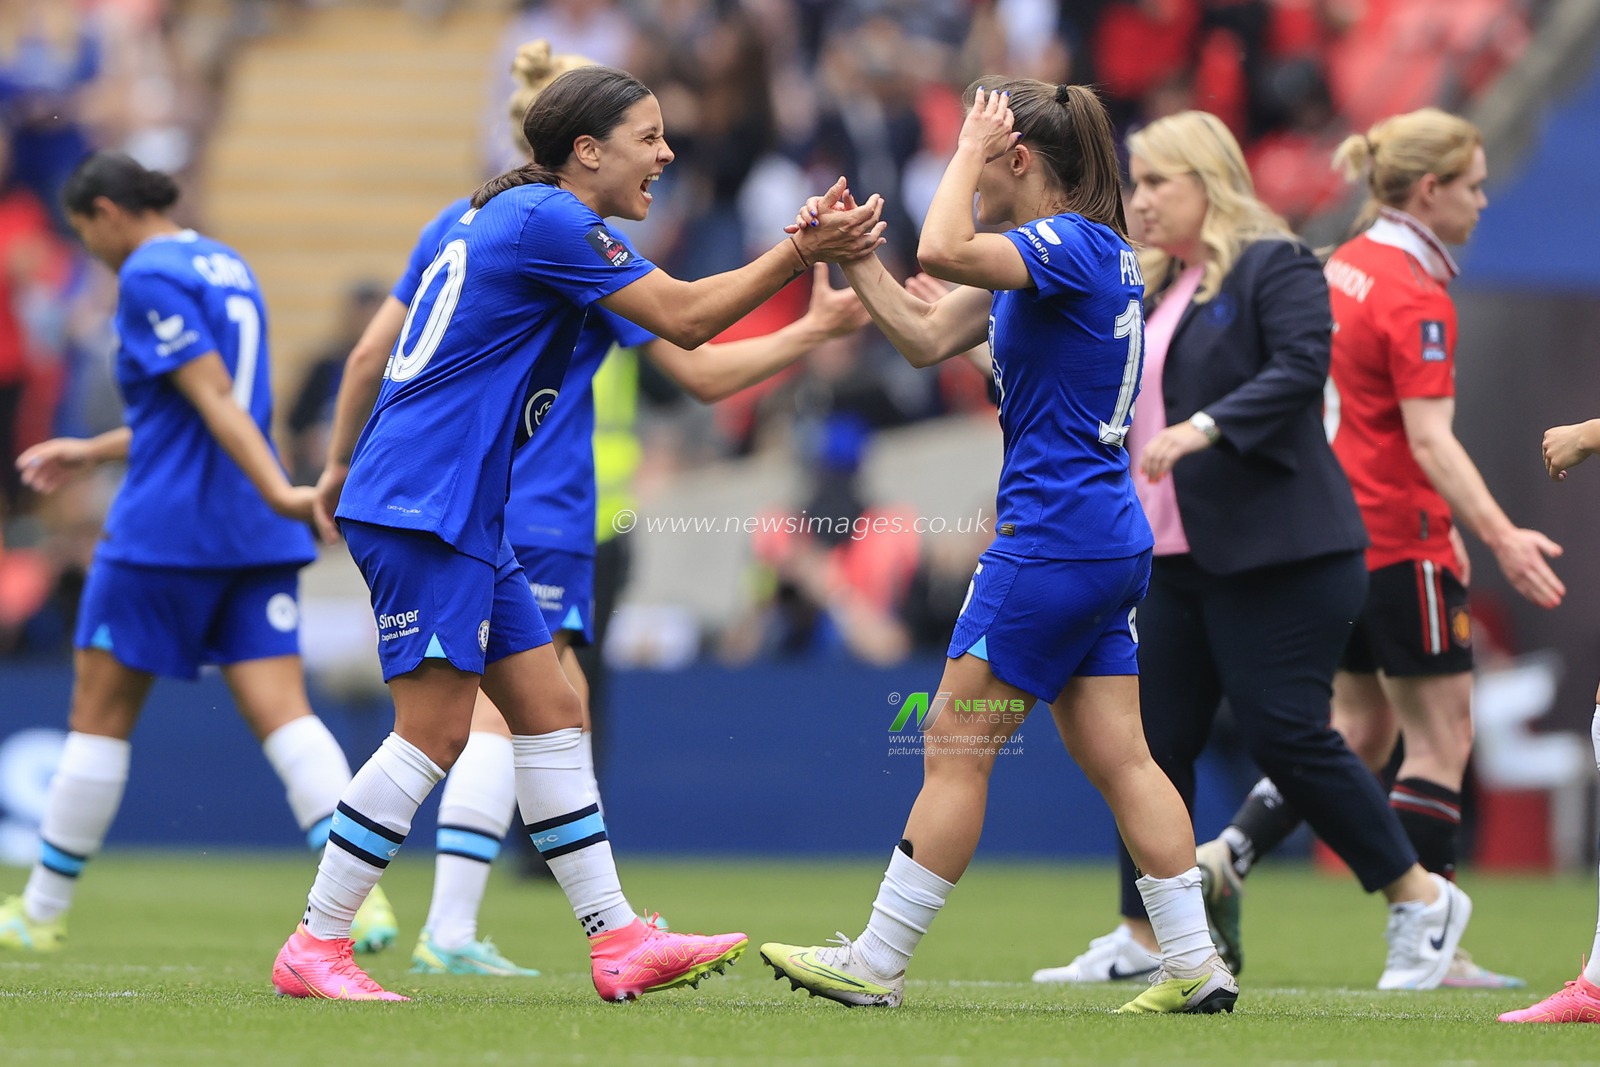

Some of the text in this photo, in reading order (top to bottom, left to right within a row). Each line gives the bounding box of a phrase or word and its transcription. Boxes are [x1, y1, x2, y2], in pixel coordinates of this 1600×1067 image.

[1017, 226, 1050, 264] WhaleFin
[383, 239, 467, 382] 0
[379, 609, 419, 630] Singer
[381, 626, 419, 642] Capital Markets
